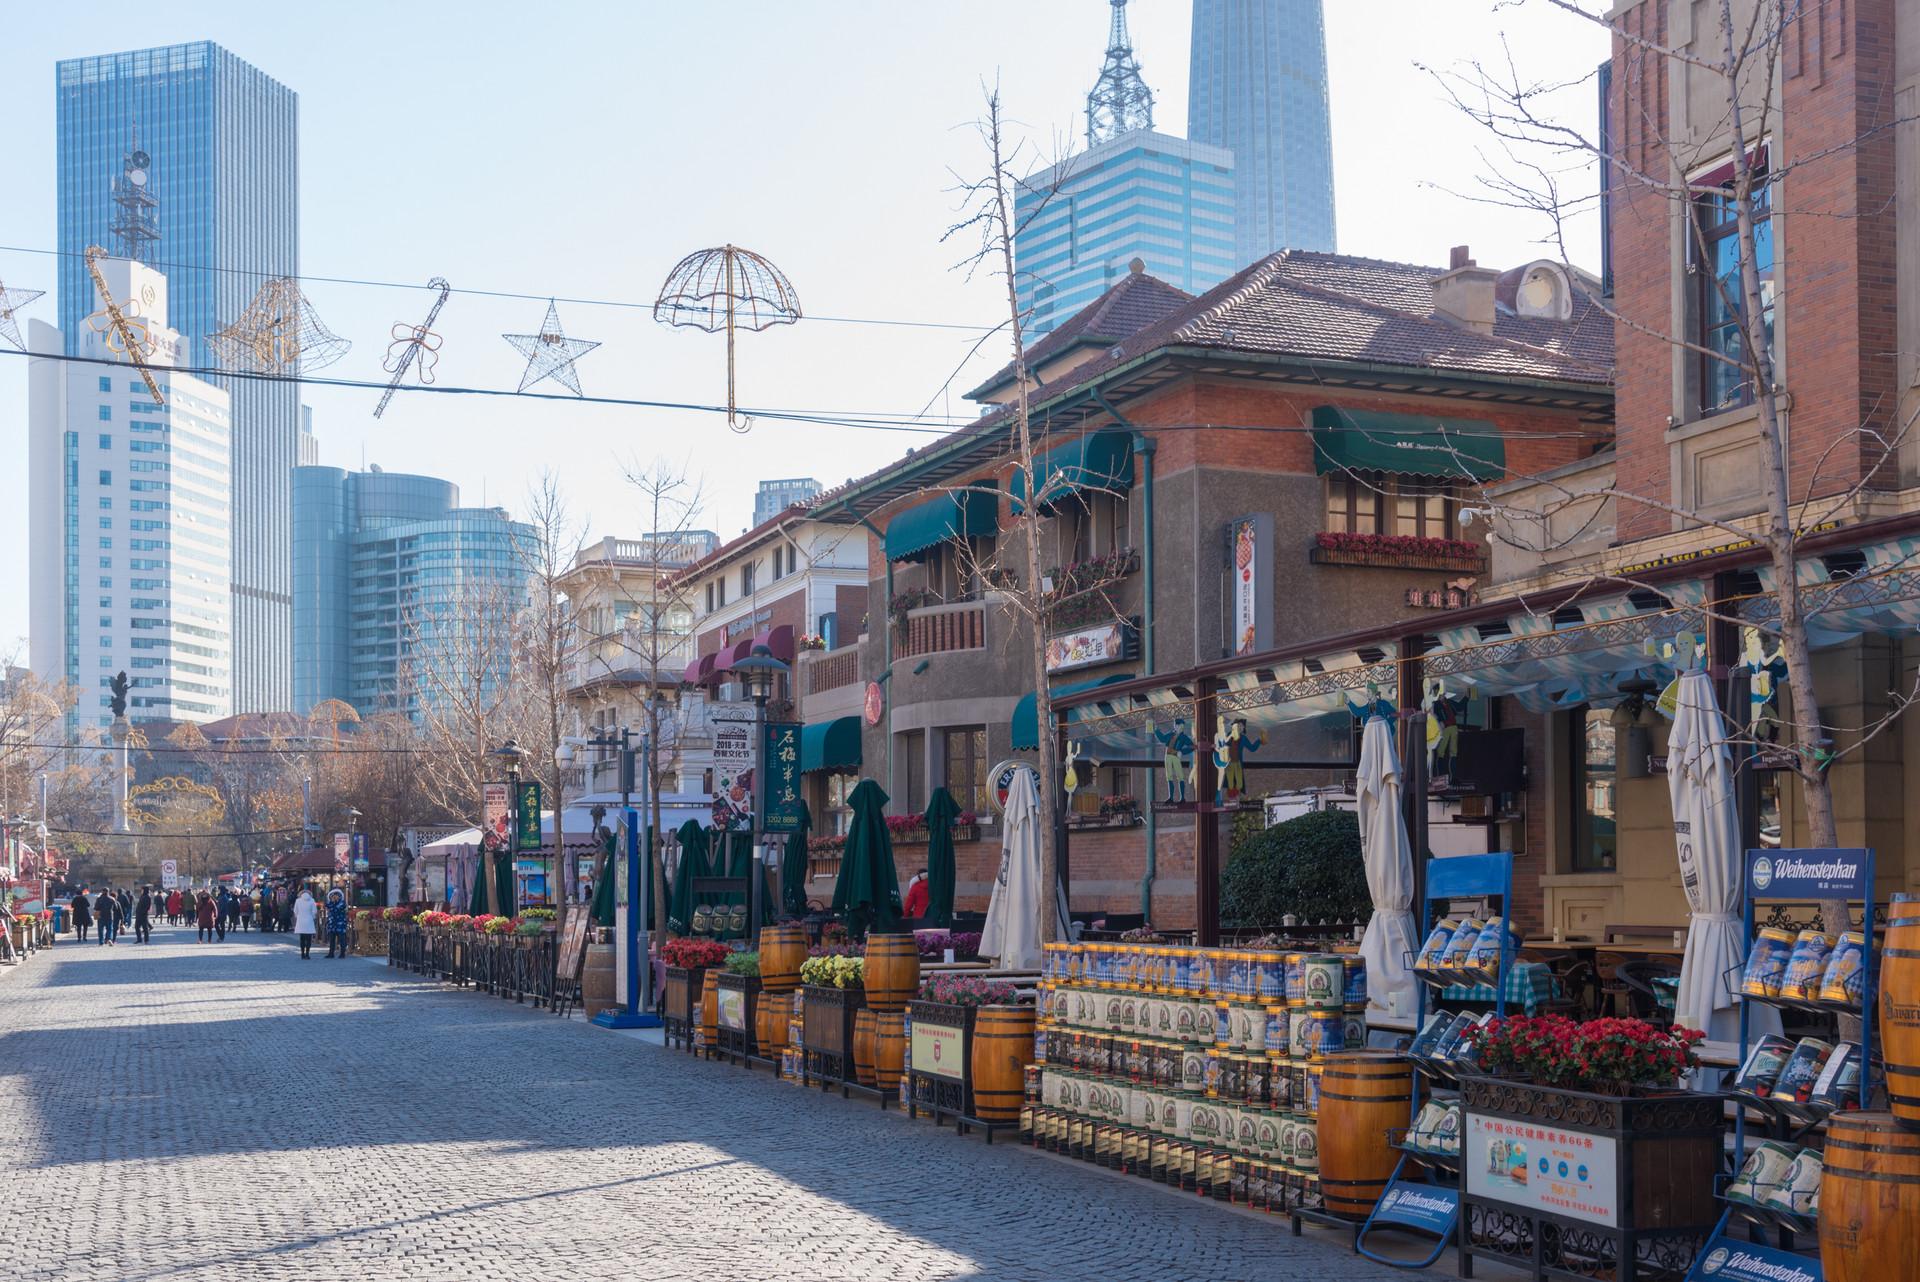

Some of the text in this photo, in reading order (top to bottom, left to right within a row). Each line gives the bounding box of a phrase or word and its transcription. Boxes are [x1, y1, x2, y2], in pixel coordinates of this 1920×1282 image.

[1775, 857, 1857, 879] Weihenstephan
[1484, 1120, 1593, 1148] 中国公民健康素养66条
[1397, 1190, 1456, 1214] Weihenstephan
[1726, 1251, 1815, 1282] Weihenstephan
